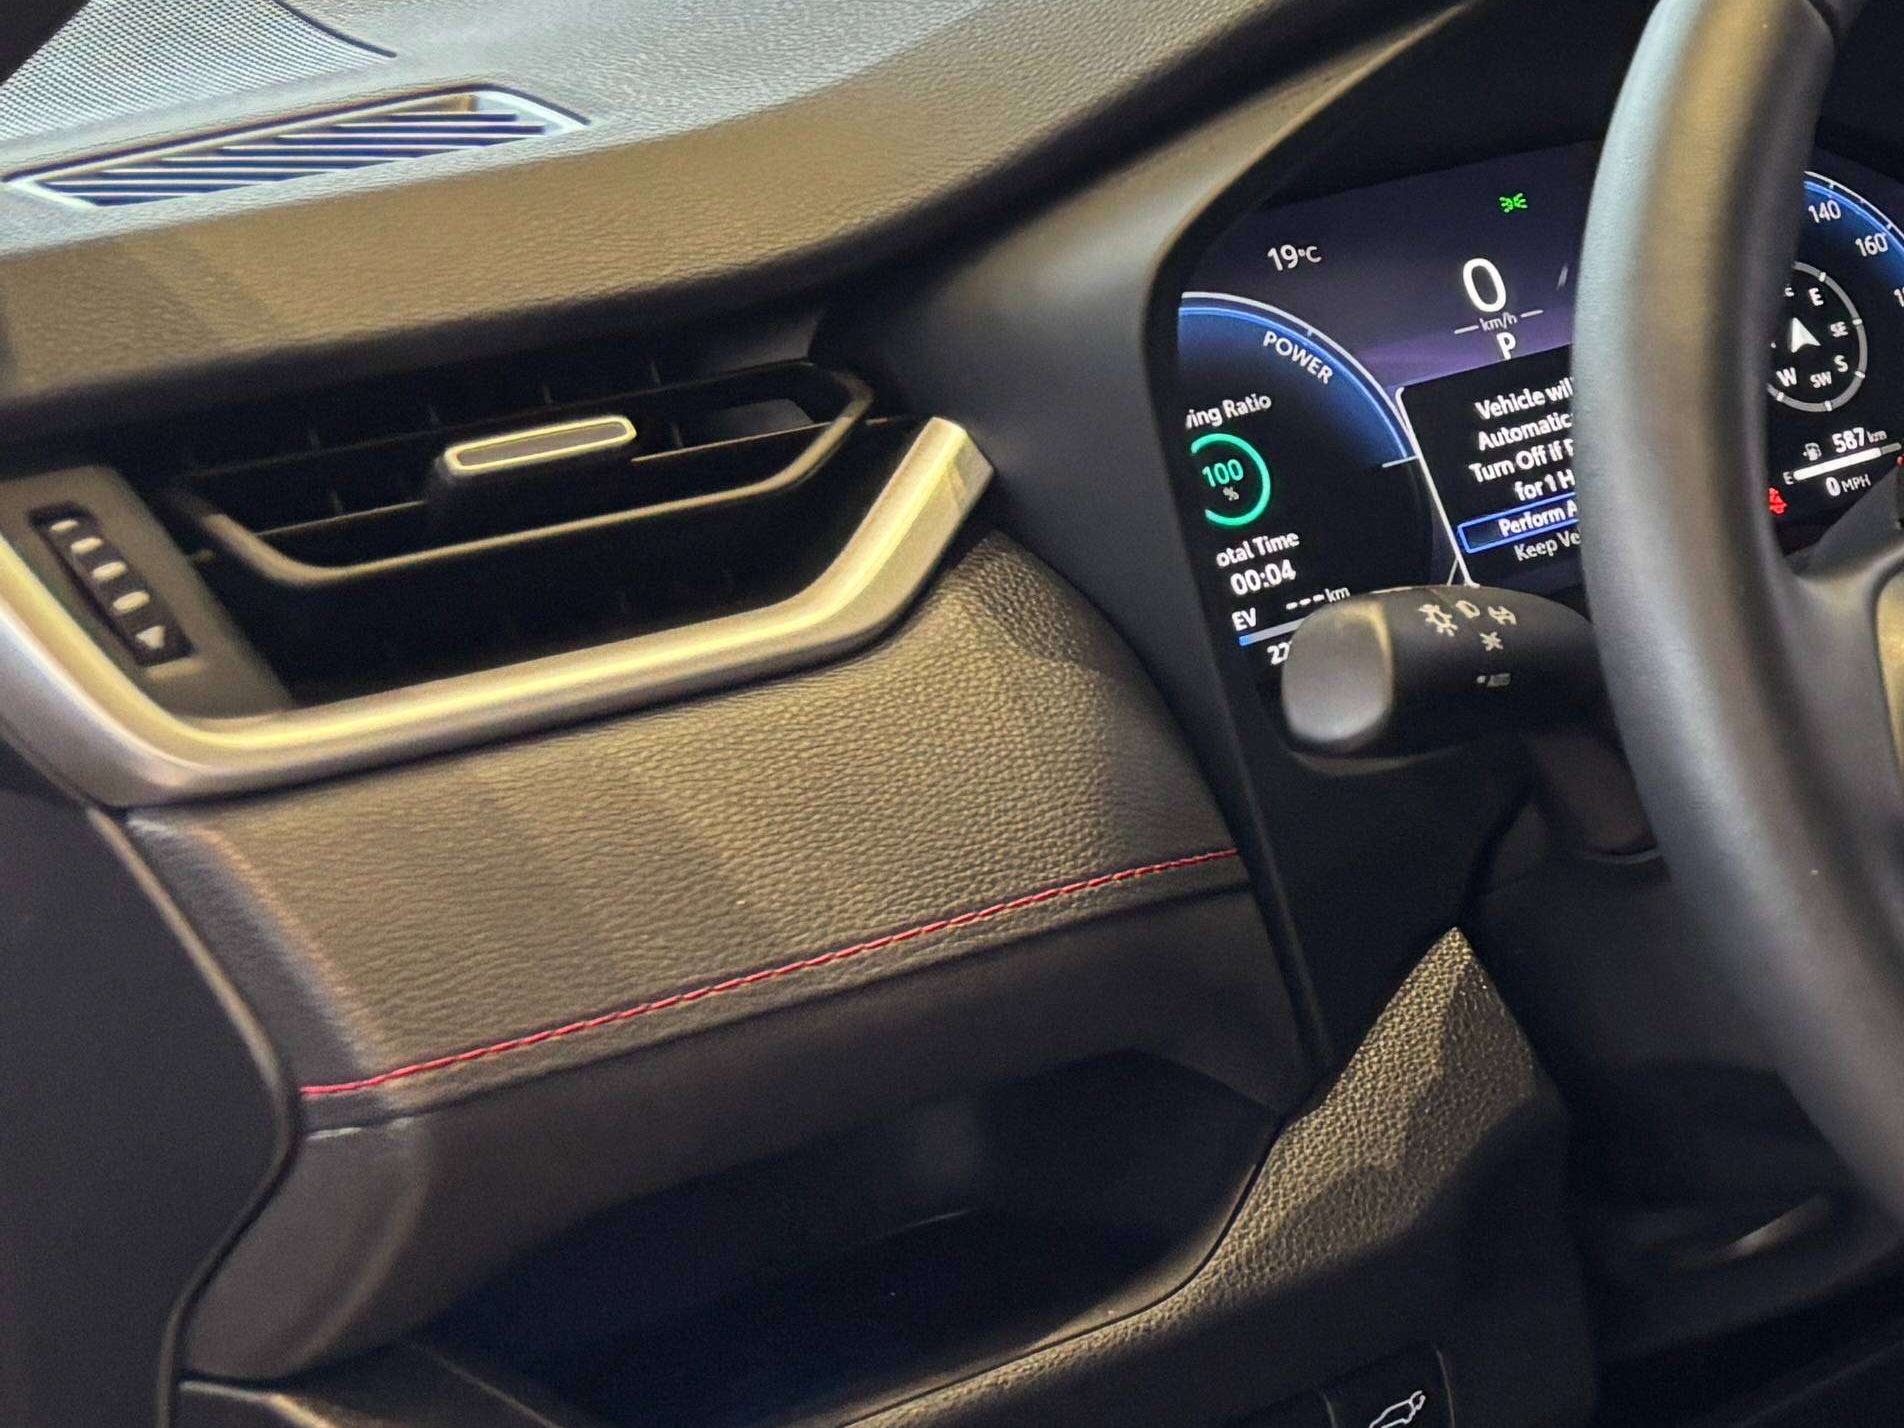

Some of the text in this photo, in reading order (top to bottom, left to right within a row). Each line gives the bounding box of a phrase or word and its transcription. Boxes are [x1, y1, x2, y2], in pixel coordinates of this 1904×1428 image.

[1808, 200, 1841, 223] 140
[1855, 233, 1889, 257] 160
[1463, 258, 1506, 312] 0
[1808, 287, 1824, 307] E
[1480, 312, 1518, 331] km/h
[1830, 321, 1848, 338] SE
[1263, 330, 1333, 384] POWER
[1496, 332, 1516, 360] P
[1834, 355, 1849, 372] S
[1776, 367, 1797, 387] W
[1810, 371, 1832, 388] SW
[1222, 393, 1272, 419] Ratio
[1474, 388, 1545, 420] Vehicle
[1832, 427, 1888, 453] 587 km
[1202, 459, 1244, 487] 100
[1468, 458, 1516, 483] Turn
[1515, 445, 1547, 471] Off
[1514, 480, 1545, 501] for
[1544, 474, 1558, 493] 1
[1782, 471, 1794, 486] E
[1826, 474, 1872, 497] 0 MPH
[1223, 487, 1240, 501] %
[1498, 506, 1566, 537] Perform
[1252, 531, 1300, 557] Time
[1513, 537, 1558, 562] Keep
[1230, 559, 1297, 596] 00:04
[1325, 585, 1351, 604] km
[1231, 607, 1258, 632] EV
